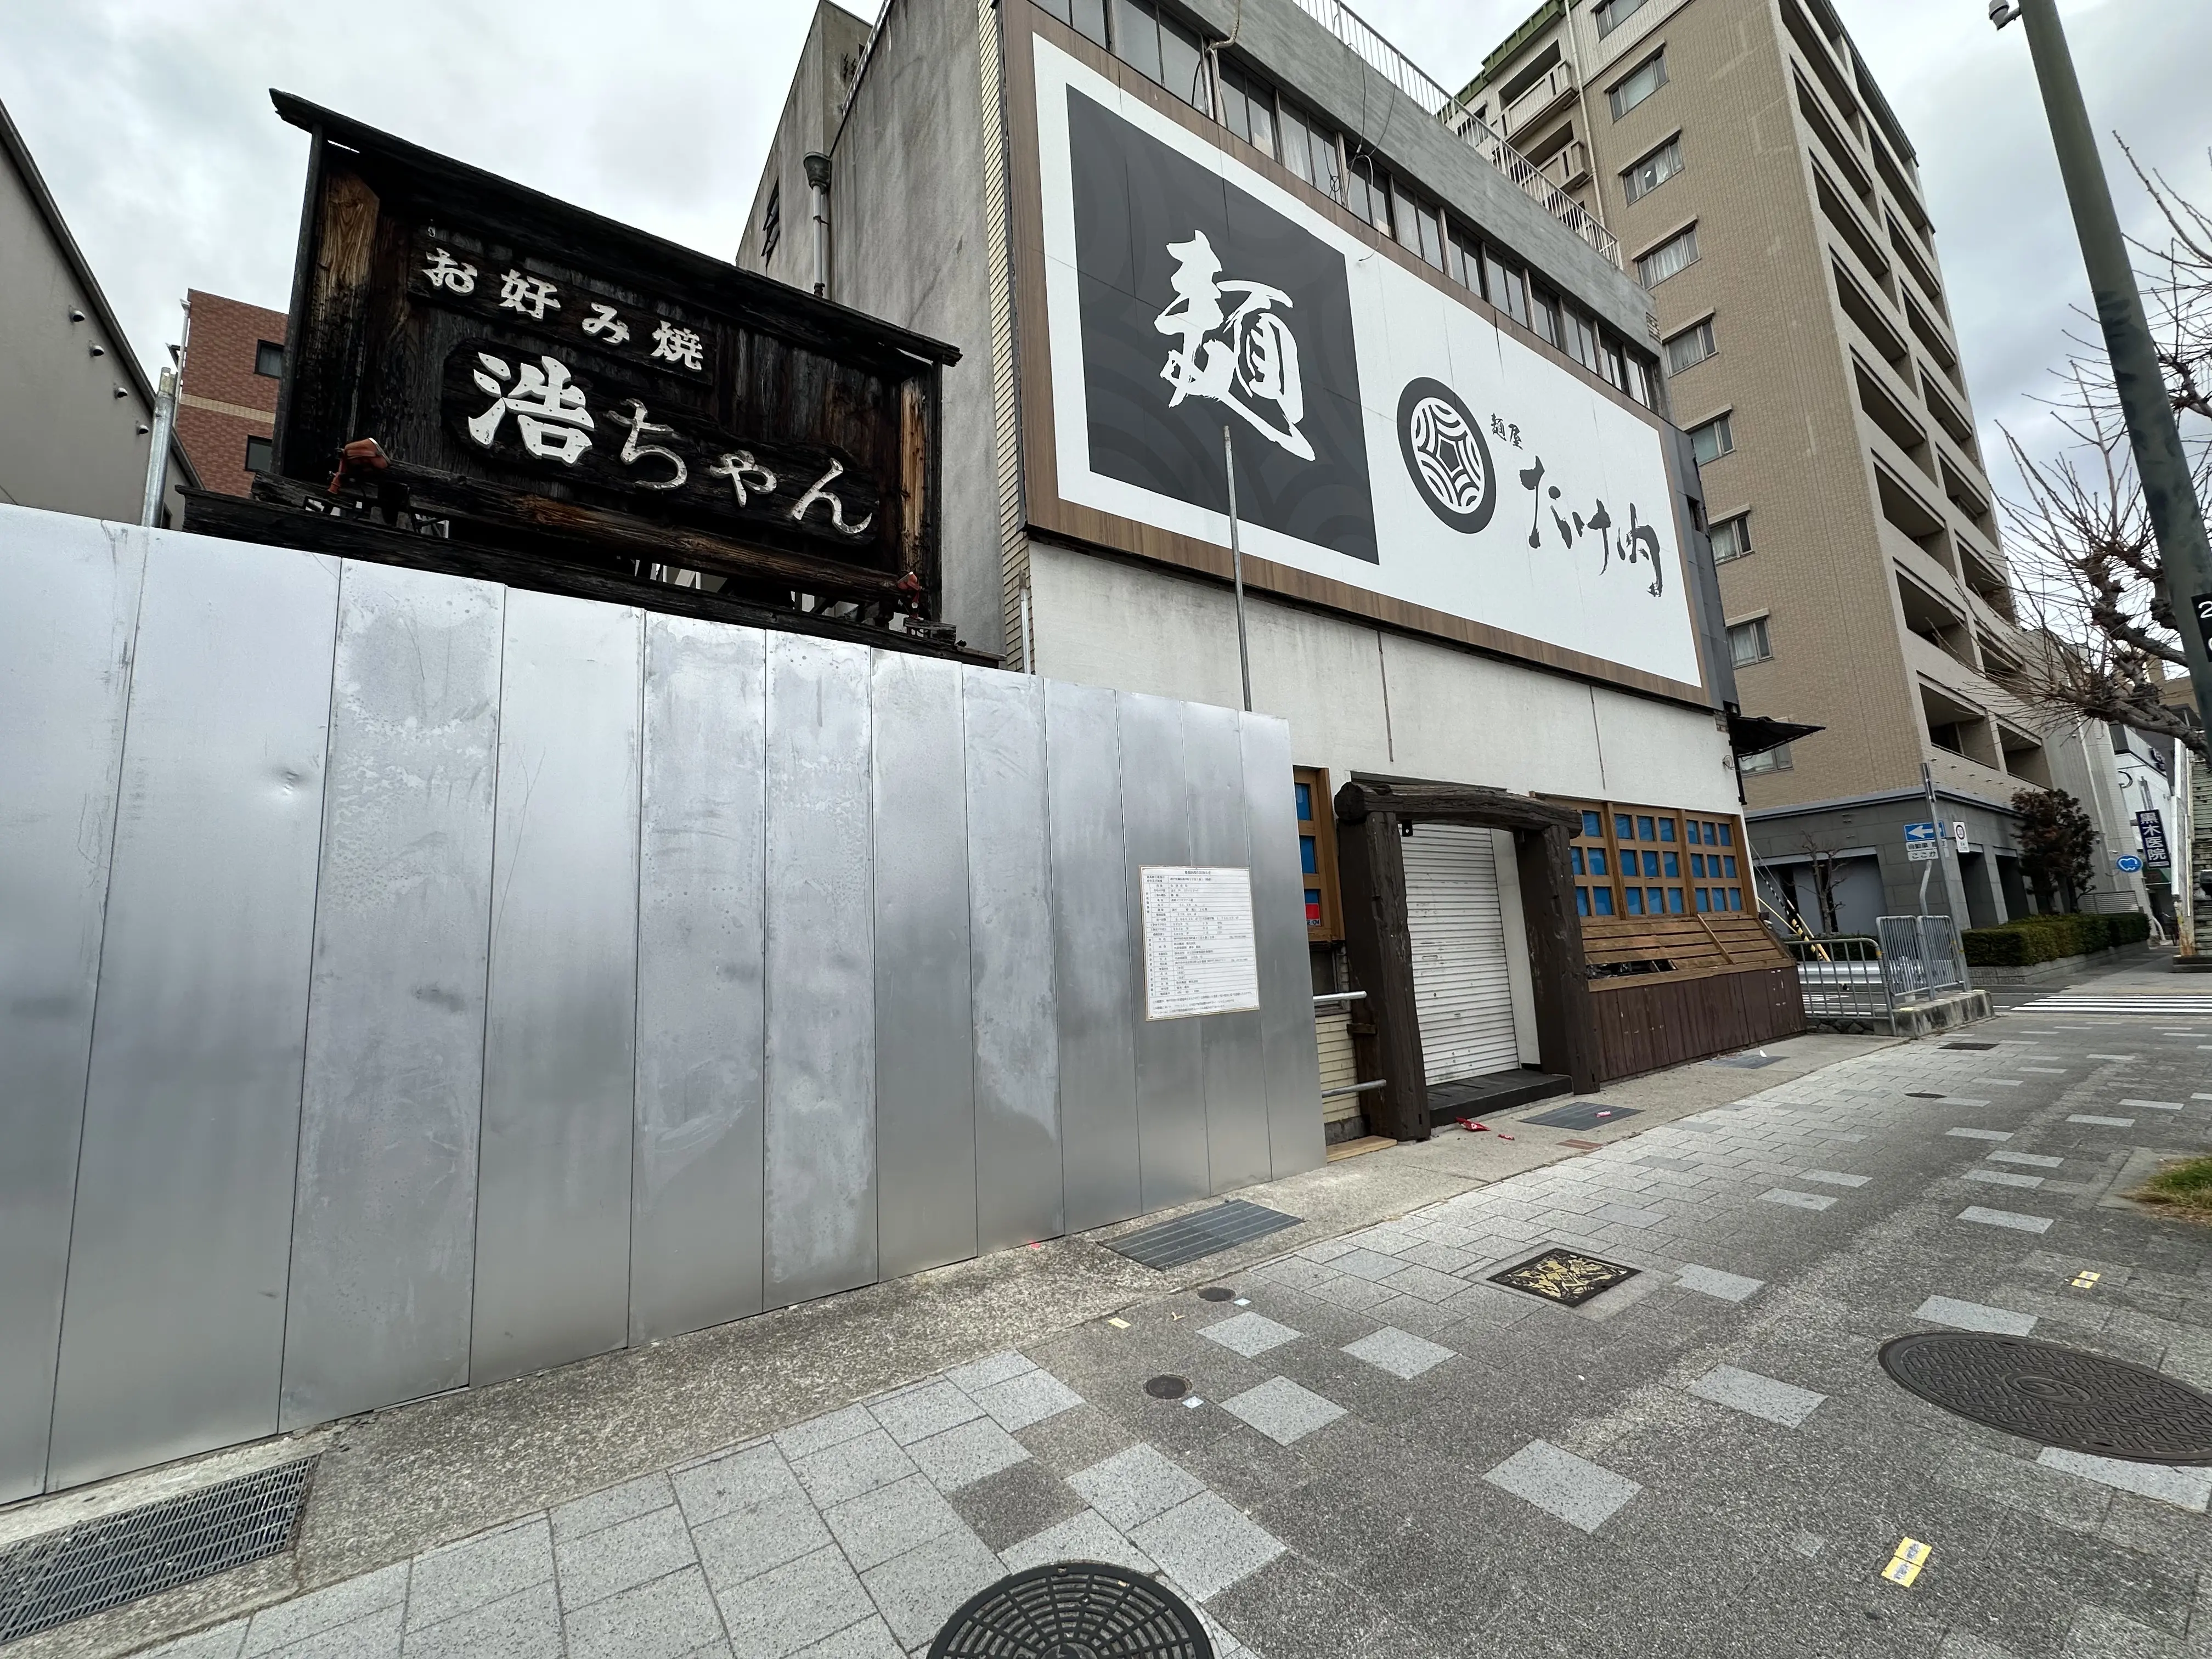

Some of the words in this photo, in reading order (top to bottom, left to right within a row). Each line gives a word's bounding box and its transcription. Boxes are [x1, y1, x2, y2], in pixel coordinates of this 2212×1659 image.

[422, 247, 703, 372] お好み焼
[468, 352, 872, 535] 浩ちゃん
[1912, 851, 1937, 859] ここか
[2140, 812, 2166, 860] 黒木医院
